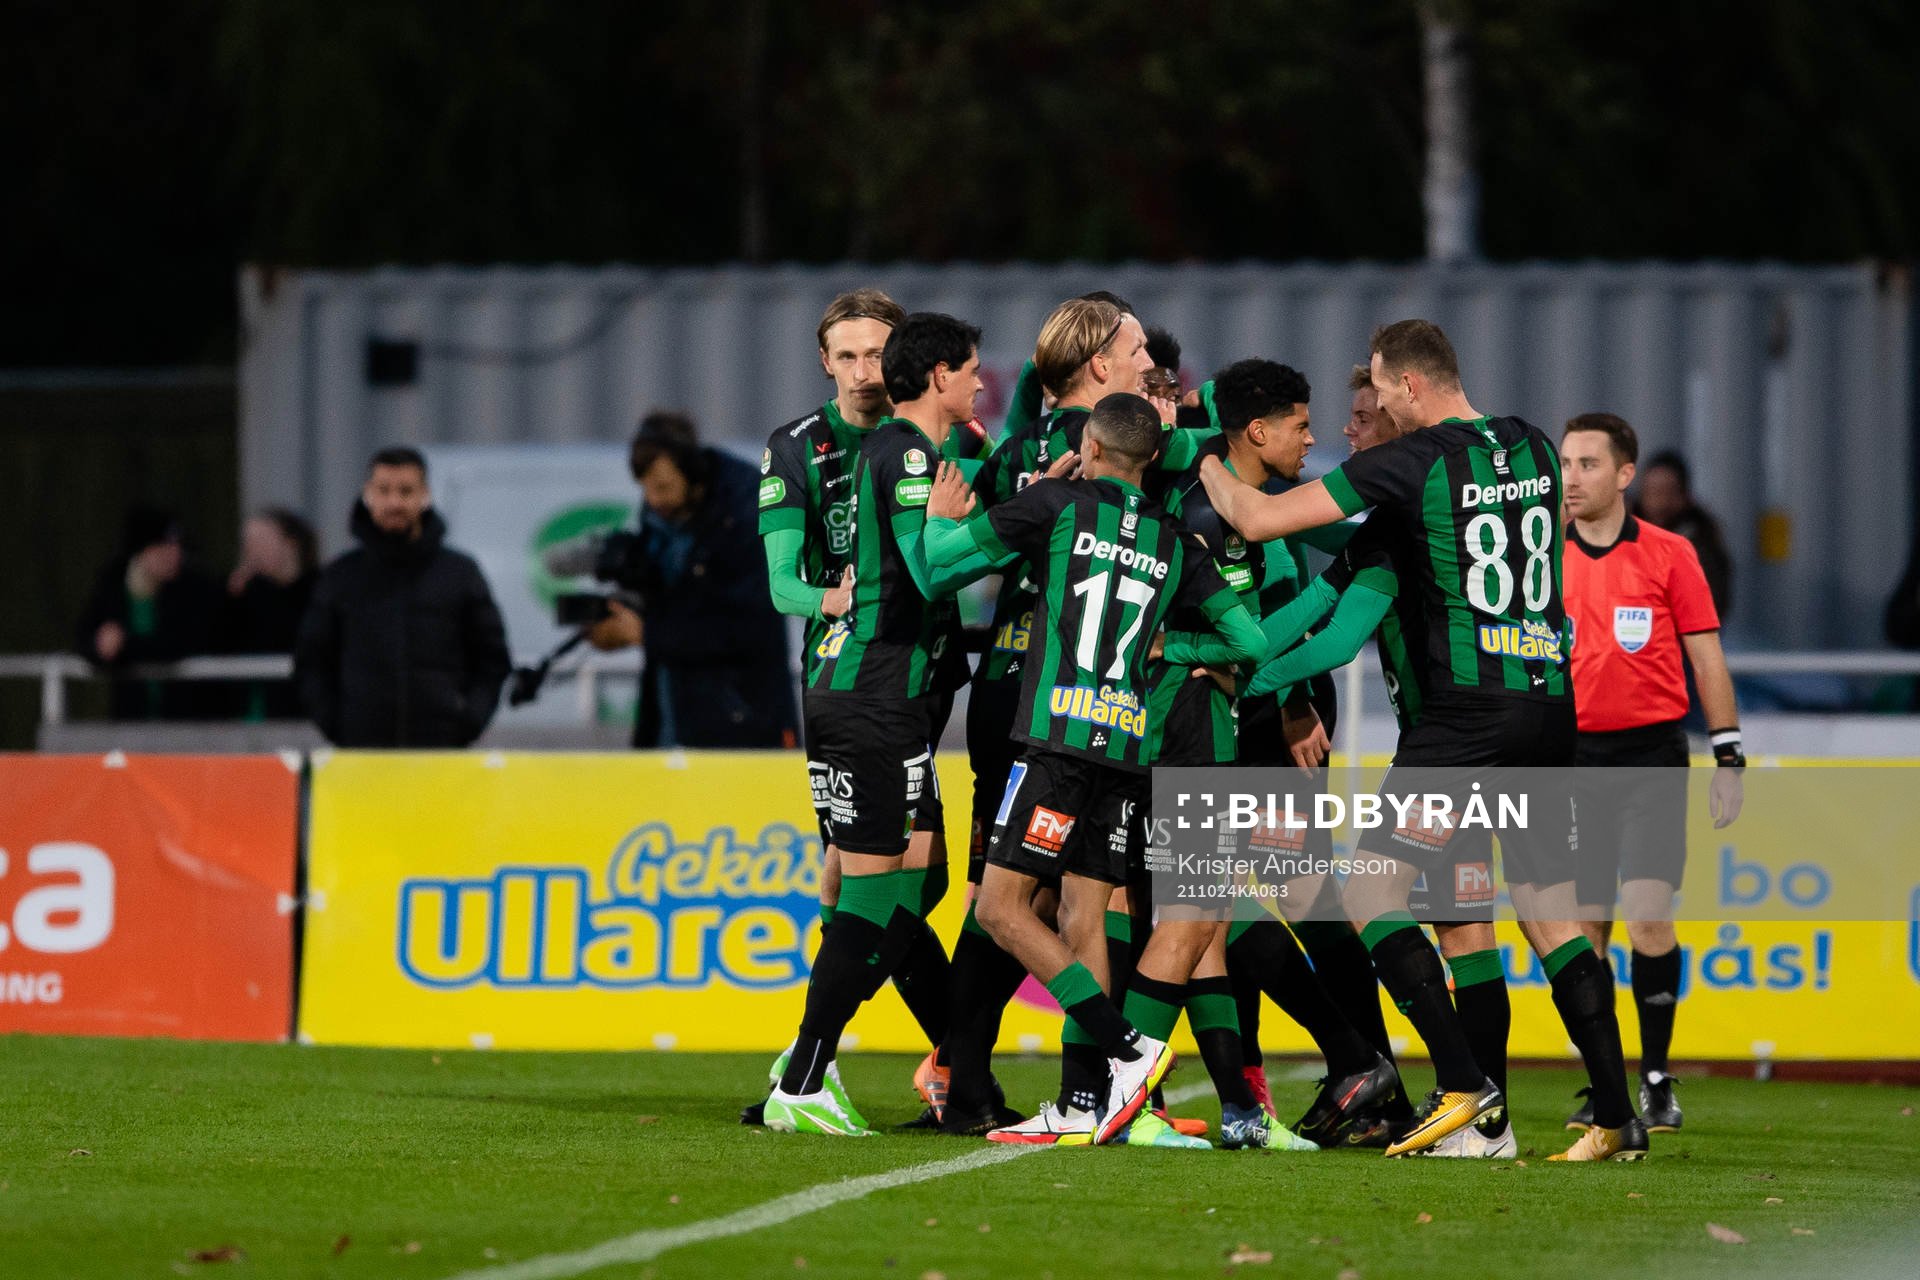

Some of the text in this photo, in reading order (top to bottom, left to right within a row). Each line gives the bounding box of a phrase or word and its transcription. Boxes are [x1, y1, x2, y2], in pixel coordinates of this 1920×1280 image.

[1461, 475, 1551, 508] Derome
[1073, 531, 1169, 580] Derome
[1465, 506, 1552, 616] 88
[1073, 570, 1156, 680] 17
[1618, 610, 1648, 621] FIFA
[1480, 625, 1562, 662] ullare
[1050, 686, 1149, 739] ullared
[1100, 685, 1139, 710] Gekås
[1144, 816, 1171, 846] VS
[1719, 845, 1832, 908] bo
